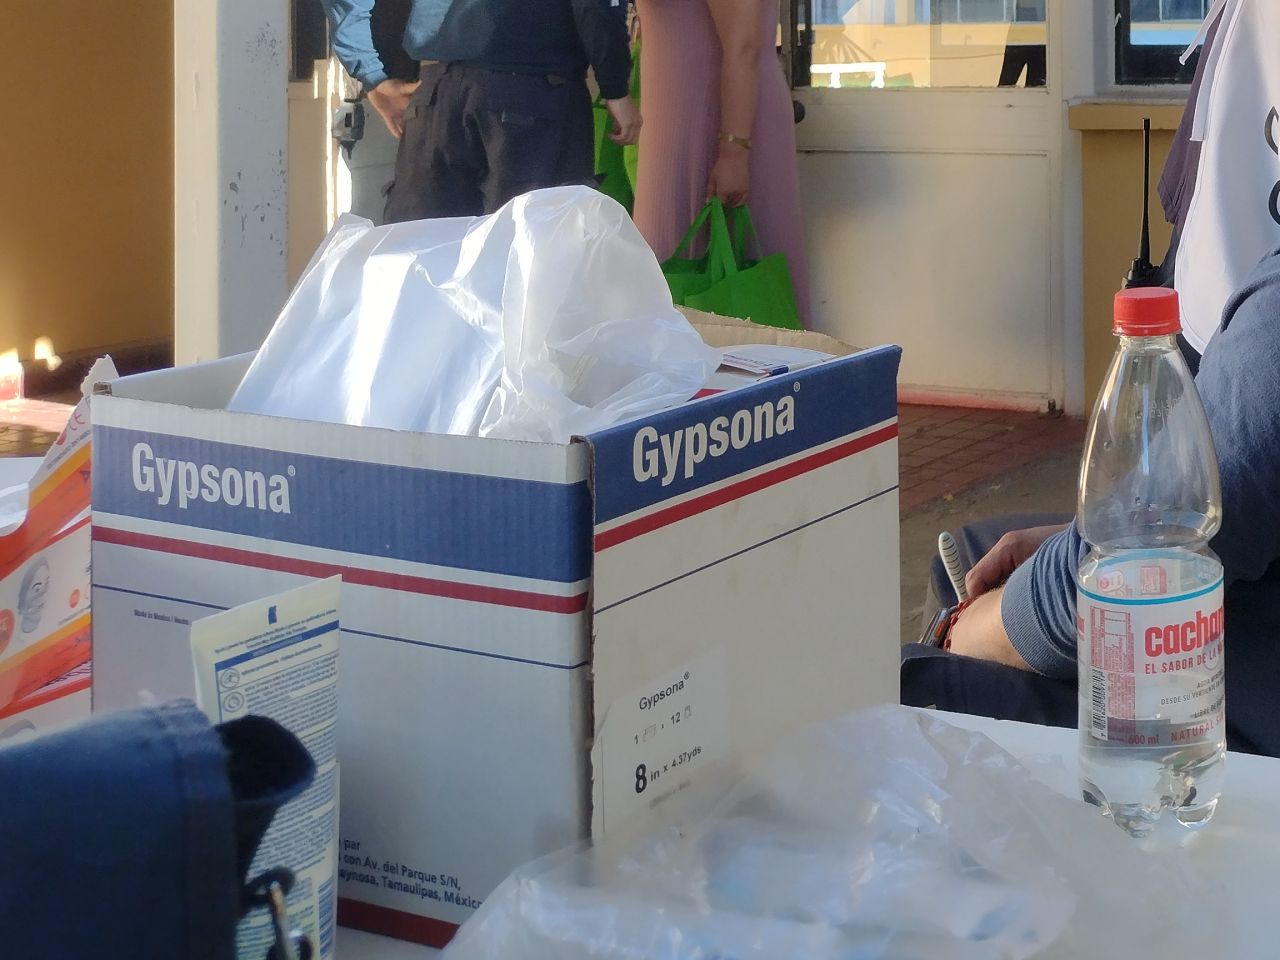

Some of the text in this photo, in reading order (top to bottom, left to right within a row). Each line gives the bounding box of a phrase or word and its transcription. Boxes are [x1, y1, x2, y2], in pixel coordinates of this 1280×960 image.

[1144, 663, 1157, 675] EL
[1162, 657, 1194, 673] SABOR
[1197, 653, 1206, 666] DE
[670, 712, 681, 725] 12
[1171, 720, 1214, 742] NATURAL
[635, 763, 648, 794] 8
[650, 769, 660, 782] in
[671, 745, 702, 768] 4.37yds
[339, 868, 379, 887] eynosa,
[381, 875, 442, 902] Tamaulipas,
[344, 854, 462, 891] con Av. del Parque S/N,
